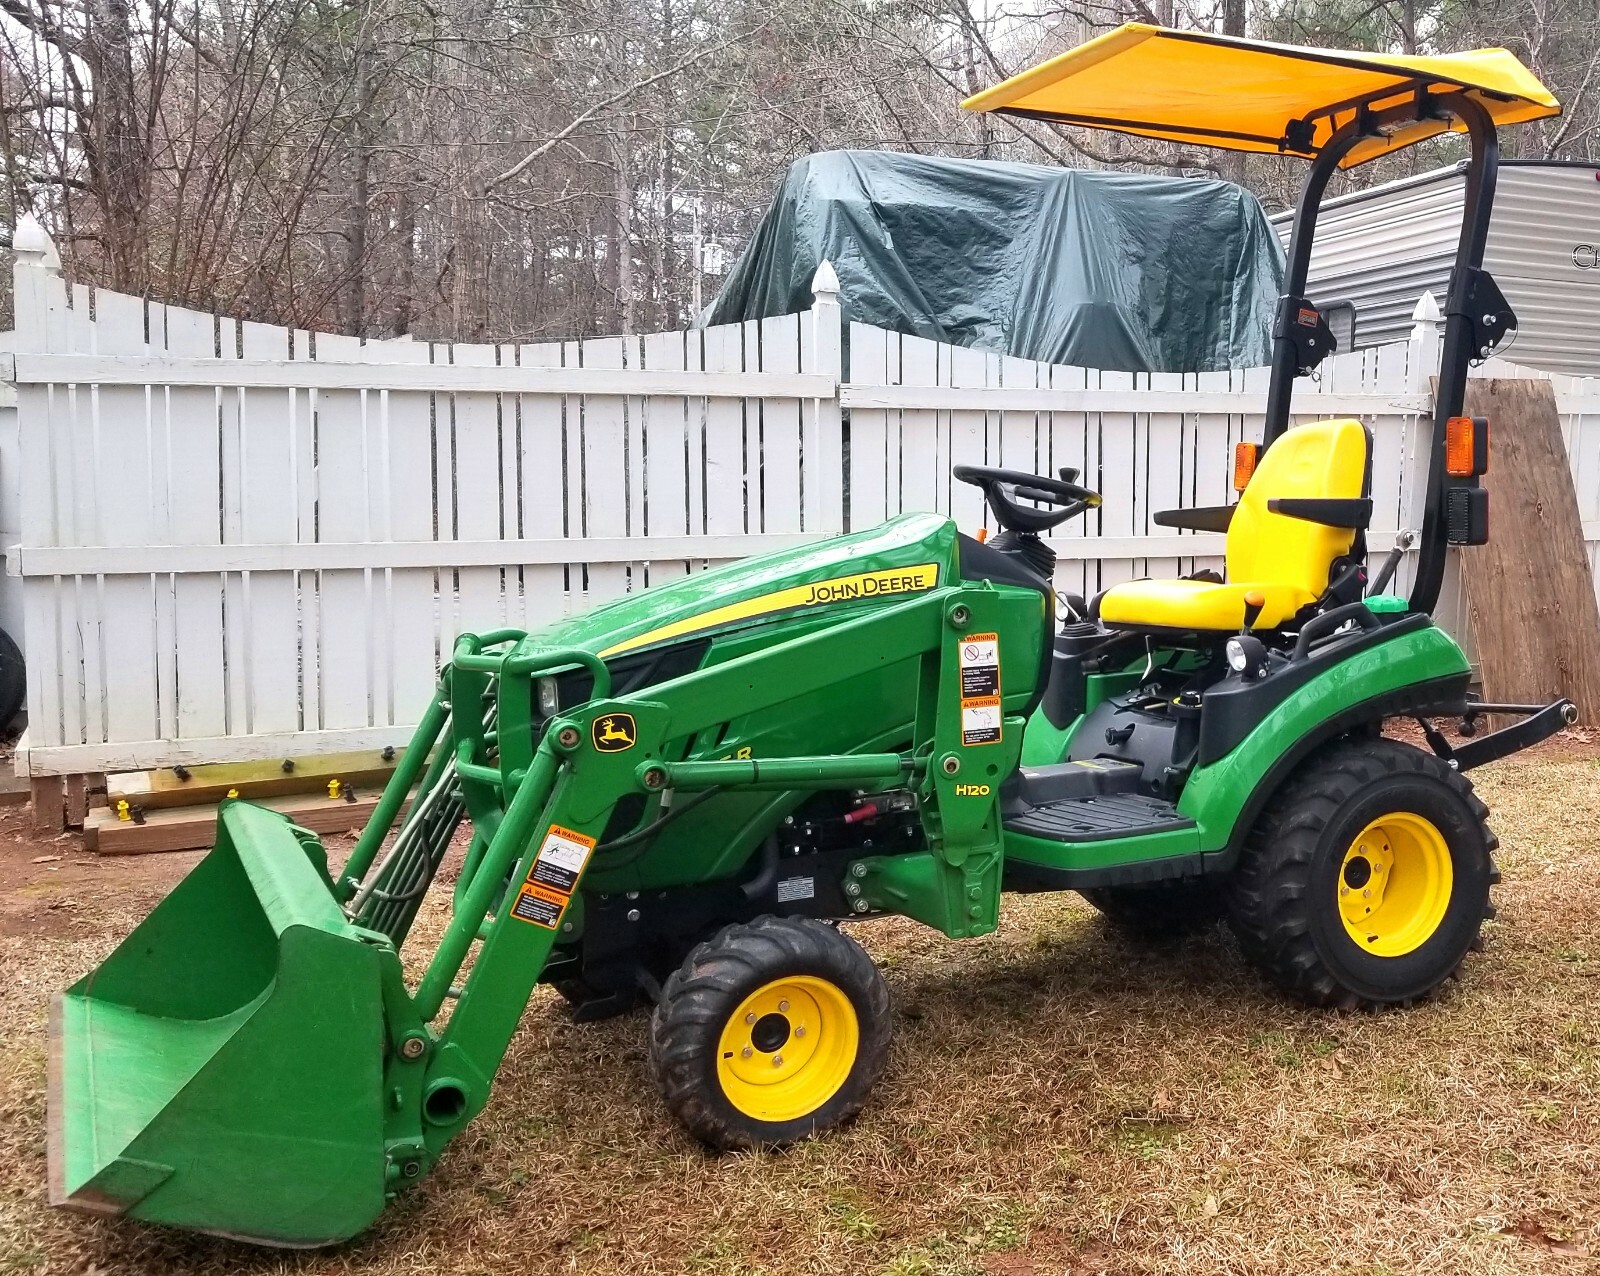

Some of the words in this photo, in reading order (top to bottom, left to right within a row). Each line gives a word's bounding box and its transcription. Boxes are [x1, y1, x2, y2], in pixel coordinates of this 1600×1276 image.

[806, 583, 859, 603] JOHN
[863, 575, 924, 593] DEERE
[966, 634, 996, 642] WARNING
[969, 699, 999, 707] WARNING
[956, 784, 990, 796] H120
[562, 831, 590, 845] WARNING
[534, 890, 563, 903] WARNING
